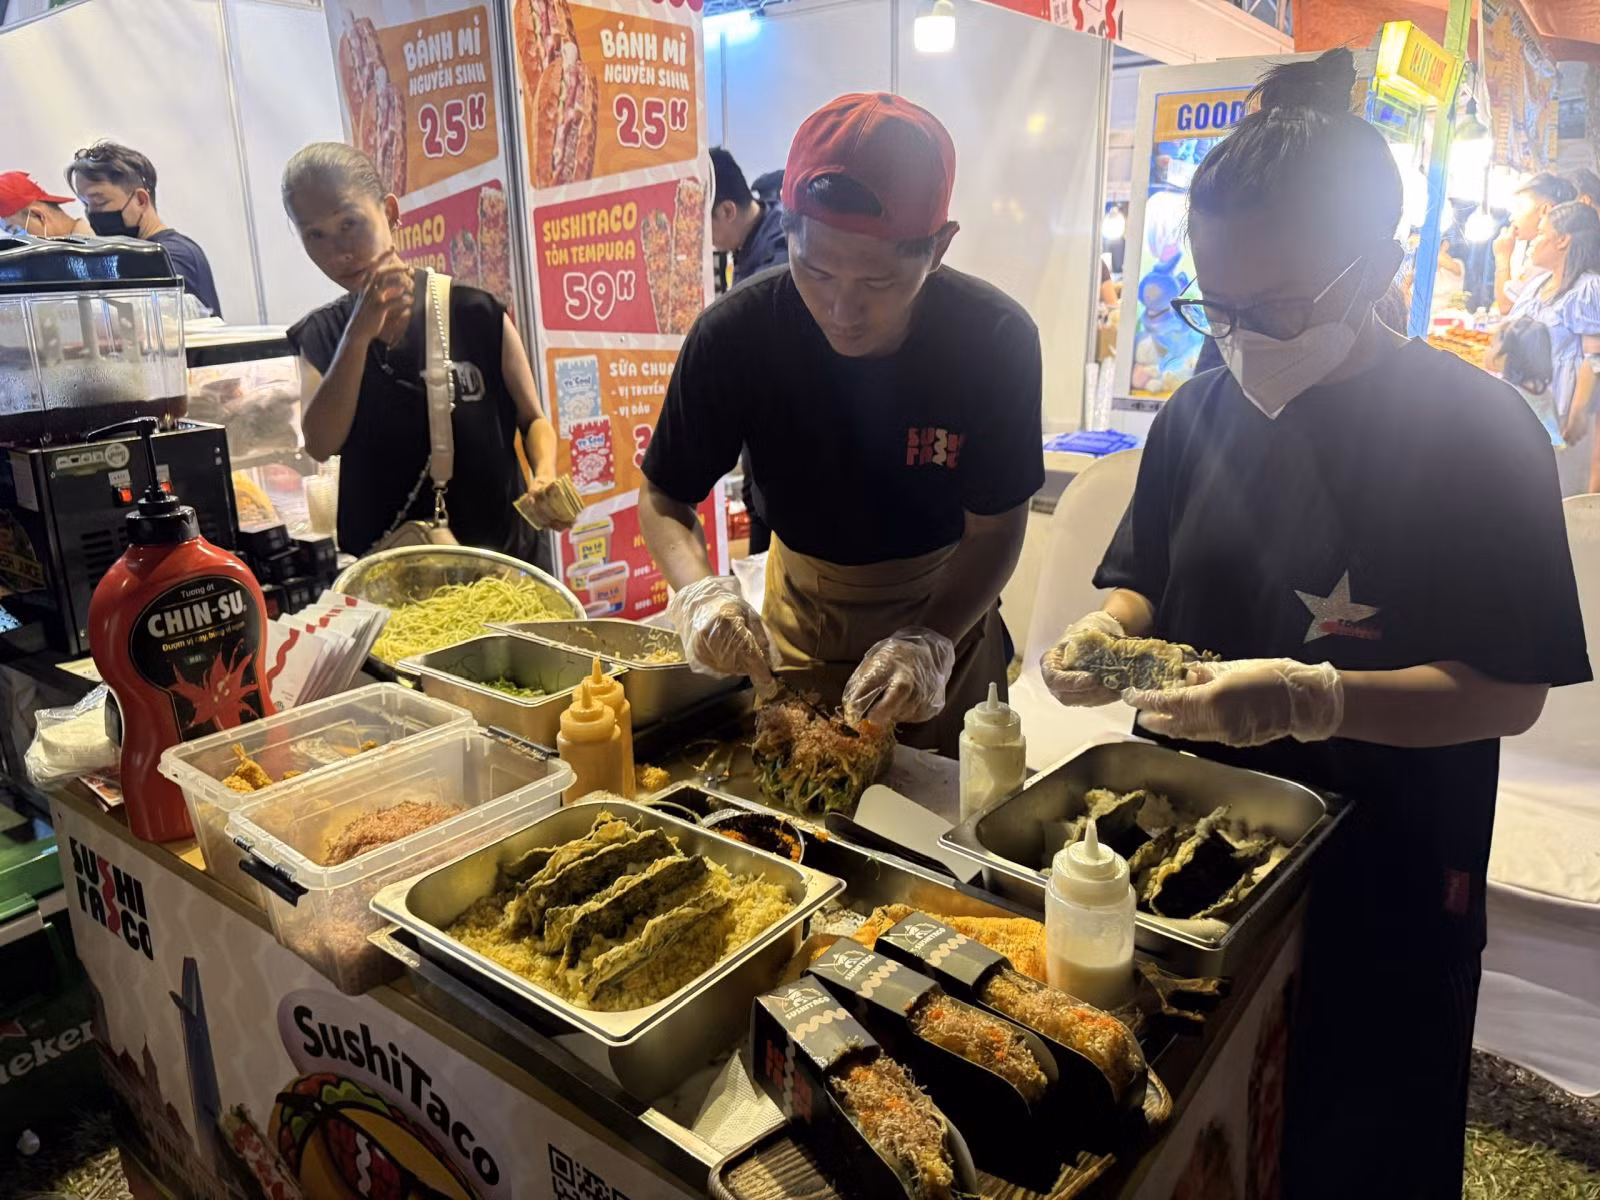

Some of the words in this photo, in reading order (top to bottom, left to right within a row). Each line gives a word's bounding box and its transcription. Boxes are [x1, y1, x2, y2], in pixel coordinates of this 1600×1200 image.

[403, 28, 454, 73] BÁNH
[600, 20, 658, 62] BÁNH
[455, 62, 487, 85] SINH
[657, 67, 690, 92] SINH
[543, 201, 638, 244] SUSHITACO
[570, 238, 636, 266] TEMPURA
[147, 589, 244, 639] CHIN-SU
[293, 1005, 500, 1187] SushiTaco
